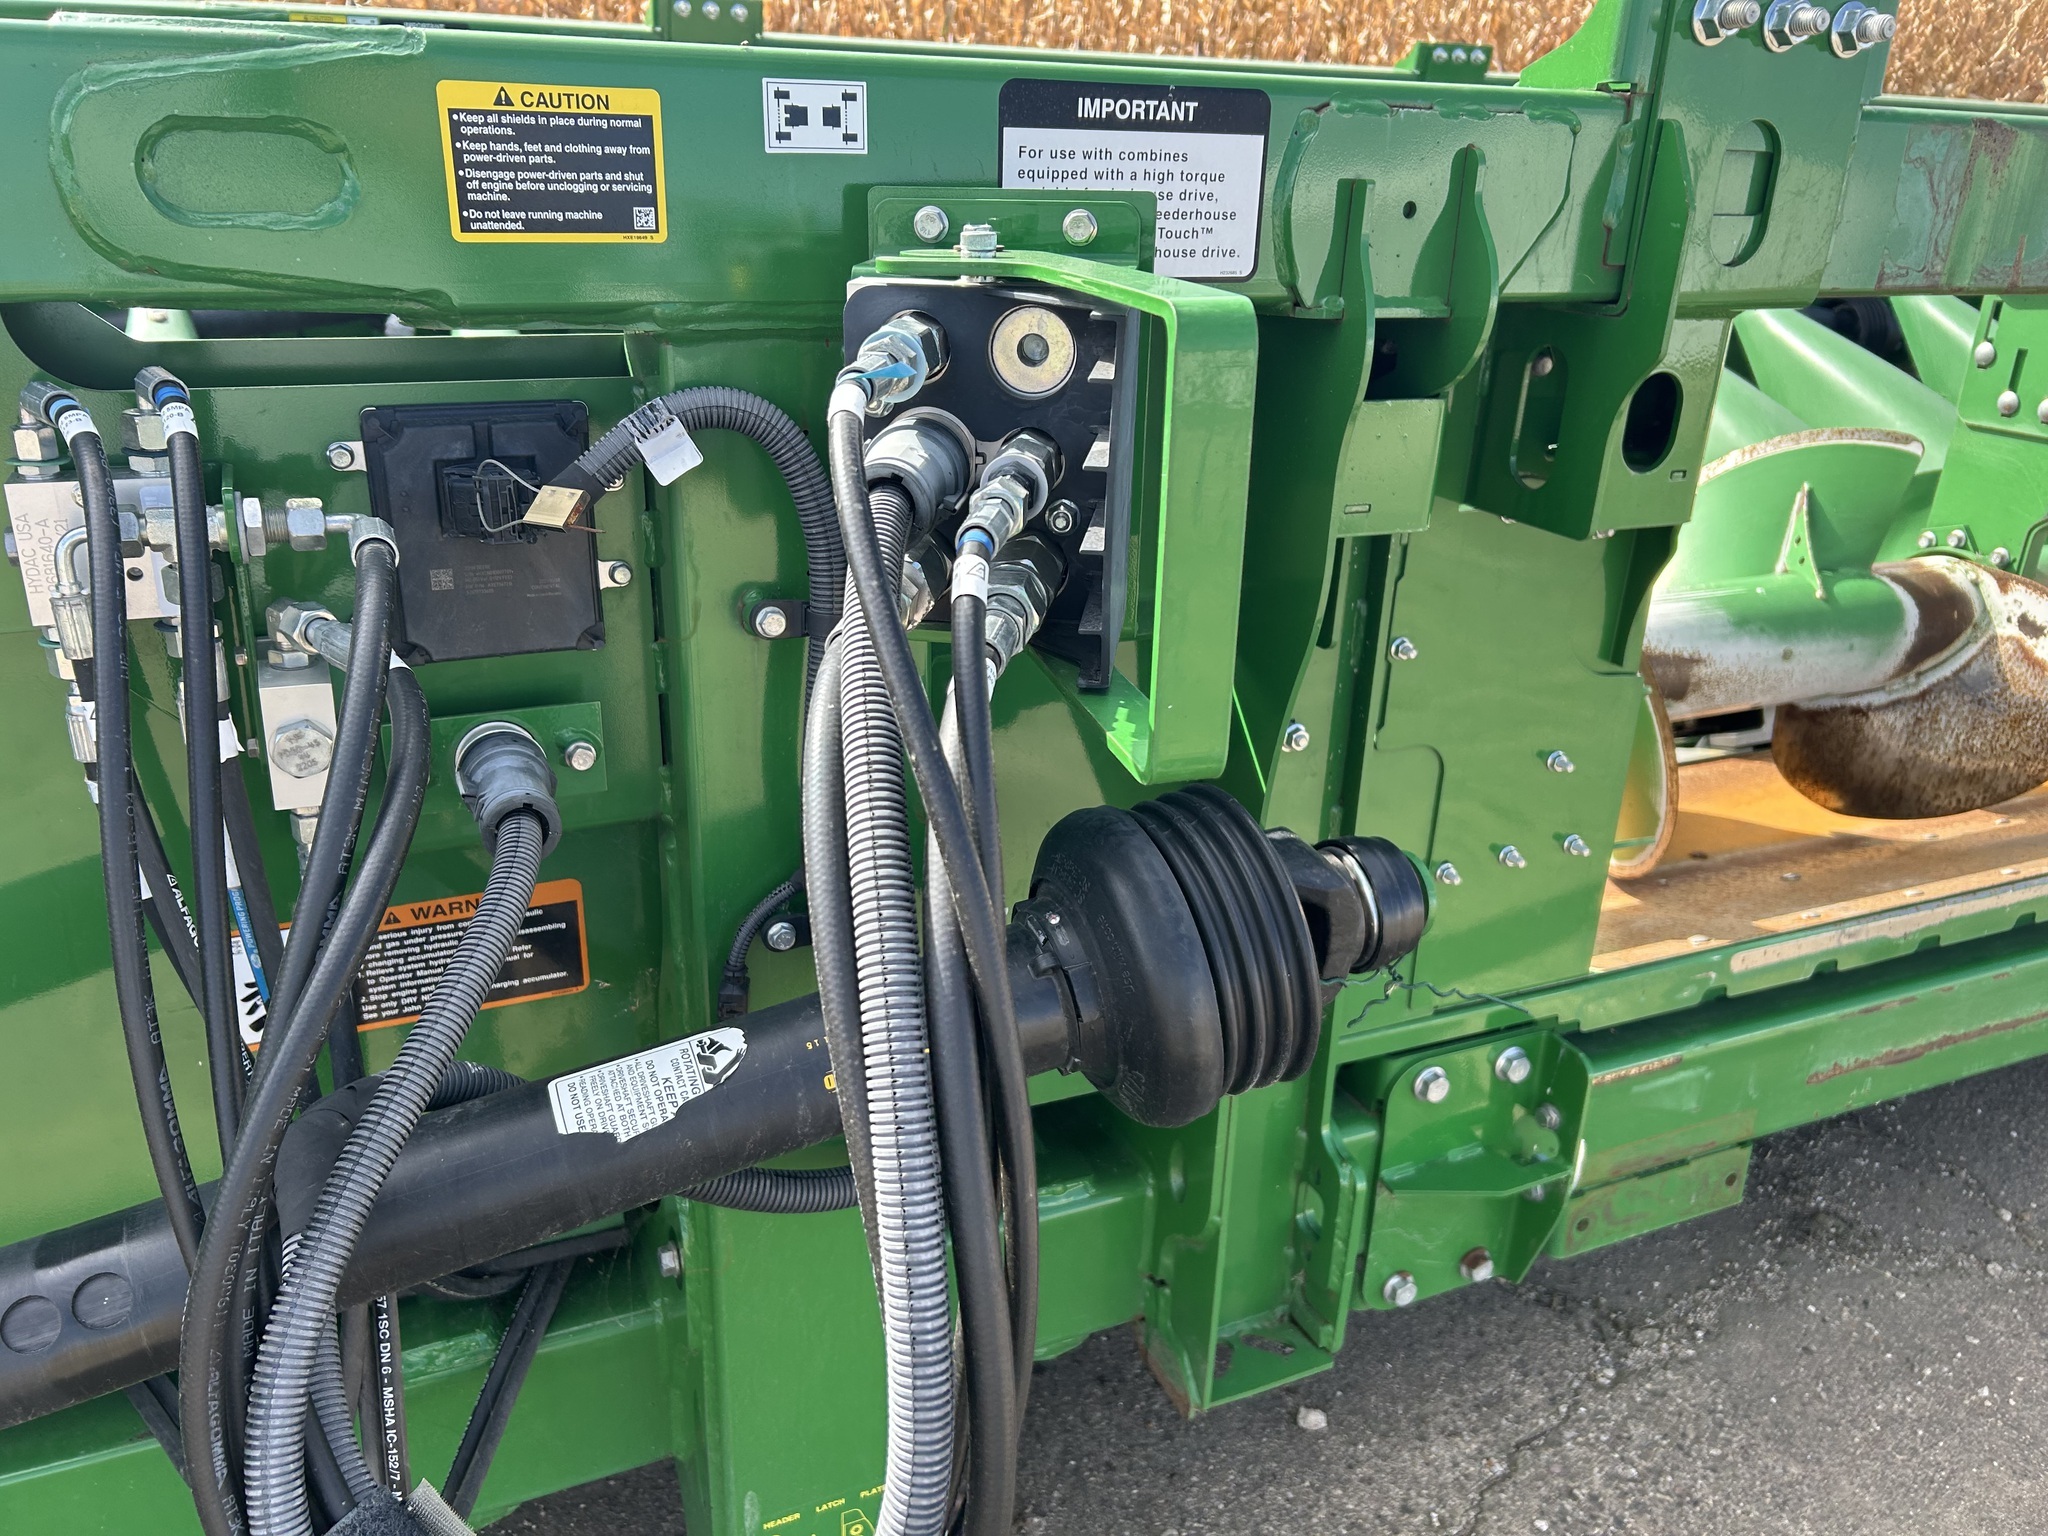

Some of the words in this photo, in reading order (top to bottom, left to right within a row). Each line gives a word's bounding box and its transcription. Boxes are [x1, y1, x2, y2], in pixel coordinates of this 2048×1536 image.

[520, 91, 609, 110] CAUTION
[1078, 98, 1198, 121] IMPORTANT
[459, 112, 484, 123] Keep
[487, 114, 498, 123] all
[501, 114, 535, 124] shields
[539, 115, 547, 124] in
[550, 116, 575, 127] place
[578, 117, 607, 128] during
[610, 118, 641, 127] normal
[461, 125, 515, 136] operations.
[462, 140, 487, 152] Keep
[490, 141, 522, 153] hands,
[524, 142, 542, 151] feet
[545, 143, 562, 152] and
[565, 143, 602, 155] clothing
[604, 146, 627, 156] away
[629, 145, 650, 154] from
[1019, 146, 1043, 159] For
[1050, 149, 1076, 159] use
[1082, 148, 1112, 160] with
[1119, 150, 1188, 162] combines
[464, 153, 526, 163] power-driven
[529, 155, 556, 165] parts.
[465, 169, 515, 180] Disengage
[518, 170, 577, 180] power-driven
[580, 171, 603, 181] parts
[605, 172, 621, 180] and
[624, 172, 644, 180] shut
[1018, 168, 1087, 180] equipped
[1094, 168, 1124, 181] with
[1130, 172, 1137, 181] a
[1143, 169, 1174, 184] high
[1180, 172, 1225, 185] torque
[466, 180, 479, 189] off
[482, 181, 513, 191] engine
[516, 181, 545, 190] before
[548, 182, 598, 193] unclogging
[612, 183, 652, 193] servicing
[468, 192, 510, 201] machine.
[1179, 189, 1218, 203] drive,
[469, 209, 482, 218] Do
[485, 210, 500, 218] not
[502, 210, 526, 219] leave
[528, 210, 563, 221] running
[565, 210, 603, 219] machine
[1156, 208, 1236, 220] eederhouse
[470, 221, 525, 229] unattended.
[1155, 247, 1196, 258] house
[1202, 246, 1239, 258] drive.
[16, 512, 32, 541] USA
[23, 548, 44, 594] HYDAC
[410, 899, 479, 920] WARN
[378, 932, 407, 940] serious
[437, 923, 454, 931] from
[384, 946, 420, 957] removing
[424, 941, 458, 951] hydraulic
[386, 941, 400, 949] gas
[404, 937, 426, 945] under
[366, 967, 394, 977] Relieve
[398, 963, 425, 971] system
[513, 944, 531, 953] Refer
[368, 957, 404, 968] changing
[380, 973, 413, 982] Operator
[417, 967, 444, 976] Manual
[369, 984, 396, 993] system
[370, 994, 388, 1002] Stop
[392, 988, 417, 998] engine
[523, 971, 568, 983] accumulator.
[401, 996, 417, 1004] DRY
[381, 1009, 398, 1018] your
[403, 1005, 421, 1013] John
[625, 1063, 635, 1076] AND
[644, 1060, 655, 1071] DO
[679, 1047, 702, 1096] ROTATING
[566, 1082, 577, 1093] DO
[586, 1075, 602, 1098] FREELY
[614, 1067, 633, 1108] DRIVESHAFT
[647, 1070, 660, 1089] NOT
[669, 1058, 687, 1090] CONTACT
[679, 1090, 690, 1102] CA
[578, 1078, 592, 1107] READING
[596, 1072, 614, 1114] DRIVESHAFT
[628, 1076, 648, 1121] EQUIPMENT
[636, 1071, 655, 1116] DRIVESHAFT
[661, 1077, 679, 1109] KEEP
[568, 1093, 582, 1111] NOT
[593, 1097, 604, 1111] ON
[615, 1102, 625, 1113] AT
[652, 1089, 671, 1122] OPERA
[573, 1112, 588, 1133] USE
[618, 1114, 633, 1138] BOTH
[244, 1268, 259, 1290] IN
[377, 1296, 387, 1309] 57
[242, 1301, 257, 1359] MADE
[378, 1313, 390, 1338] 1SC
[380, 1344, 391, 1362] DN
[381, 1366, 392, 1374] 6
[383, 1387, 395, 1425] MSHA
[387, 1429, 400, 1480] IC-152/7
[763, 1513, 800, 1529] HEADER
[816, 1498, 845, 1512] LATCH
